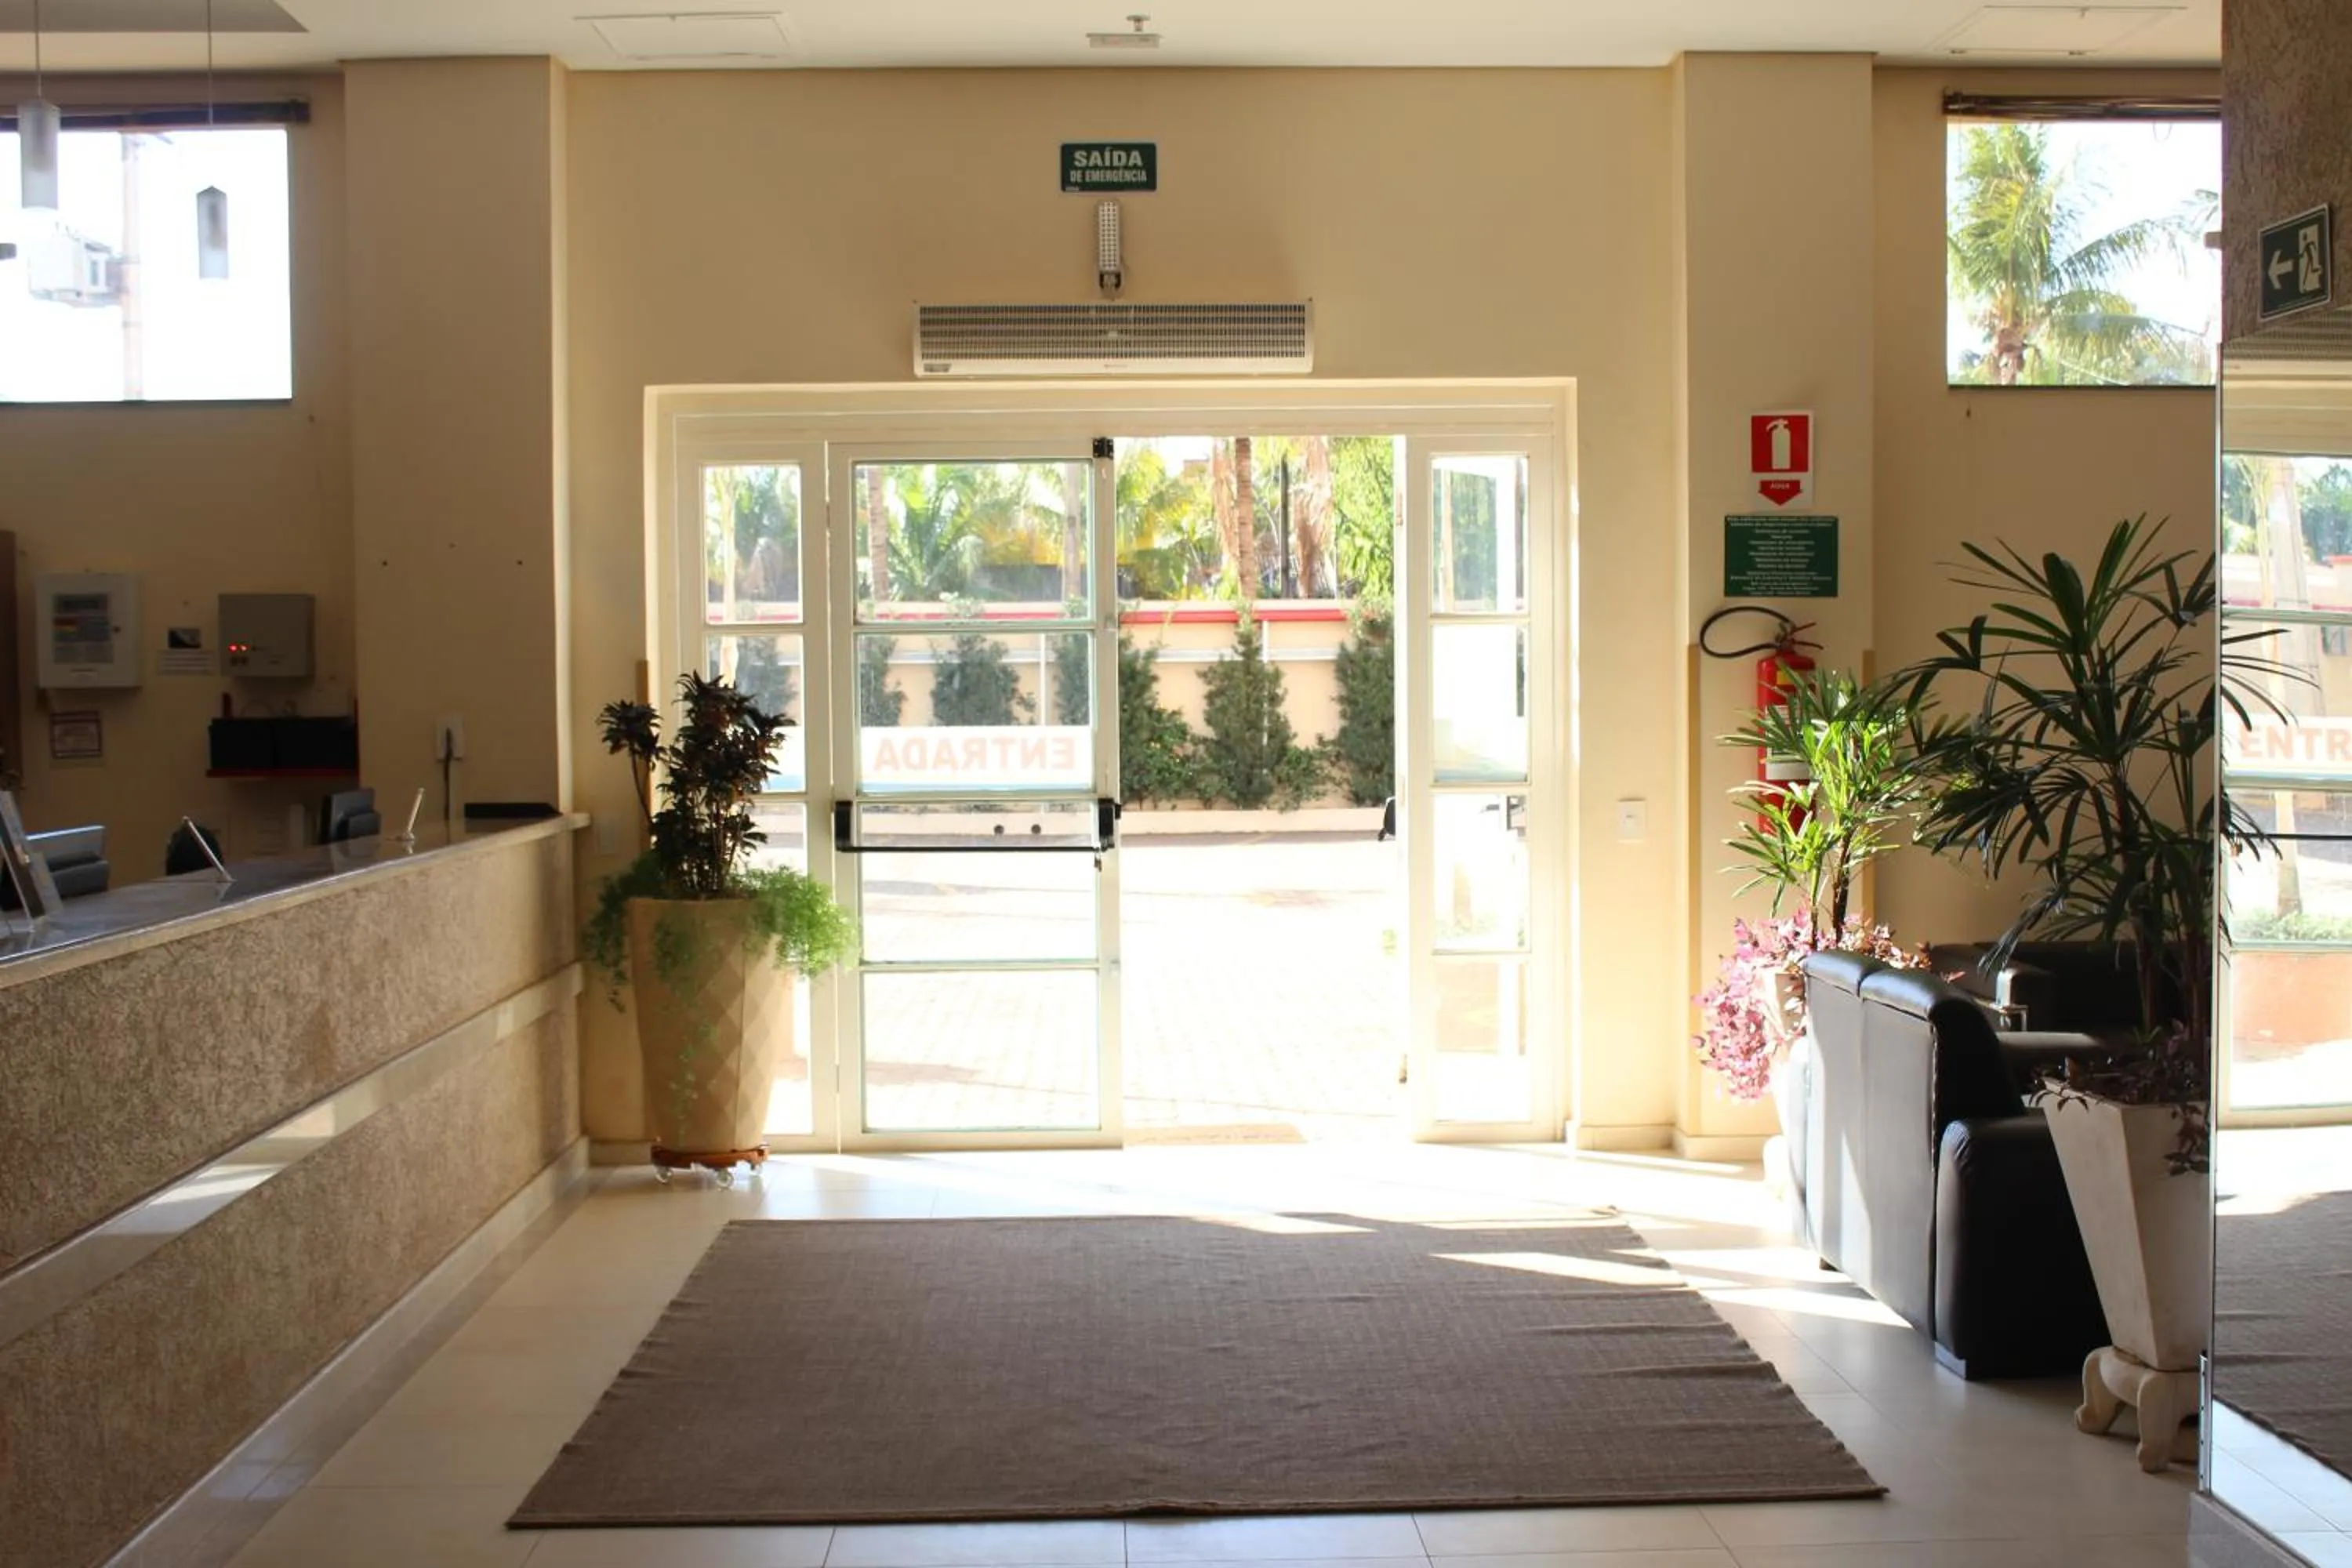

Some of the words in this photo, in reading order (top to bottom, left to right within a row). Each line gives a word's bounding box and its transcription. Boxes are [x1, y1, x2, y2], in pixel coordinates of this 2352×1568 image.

[1073, 147, 1143, 167] SAÍDA
[1070, 169, 1083, 183] DE
[1085, 169, 1147, 183] EMERGÊNCIA
